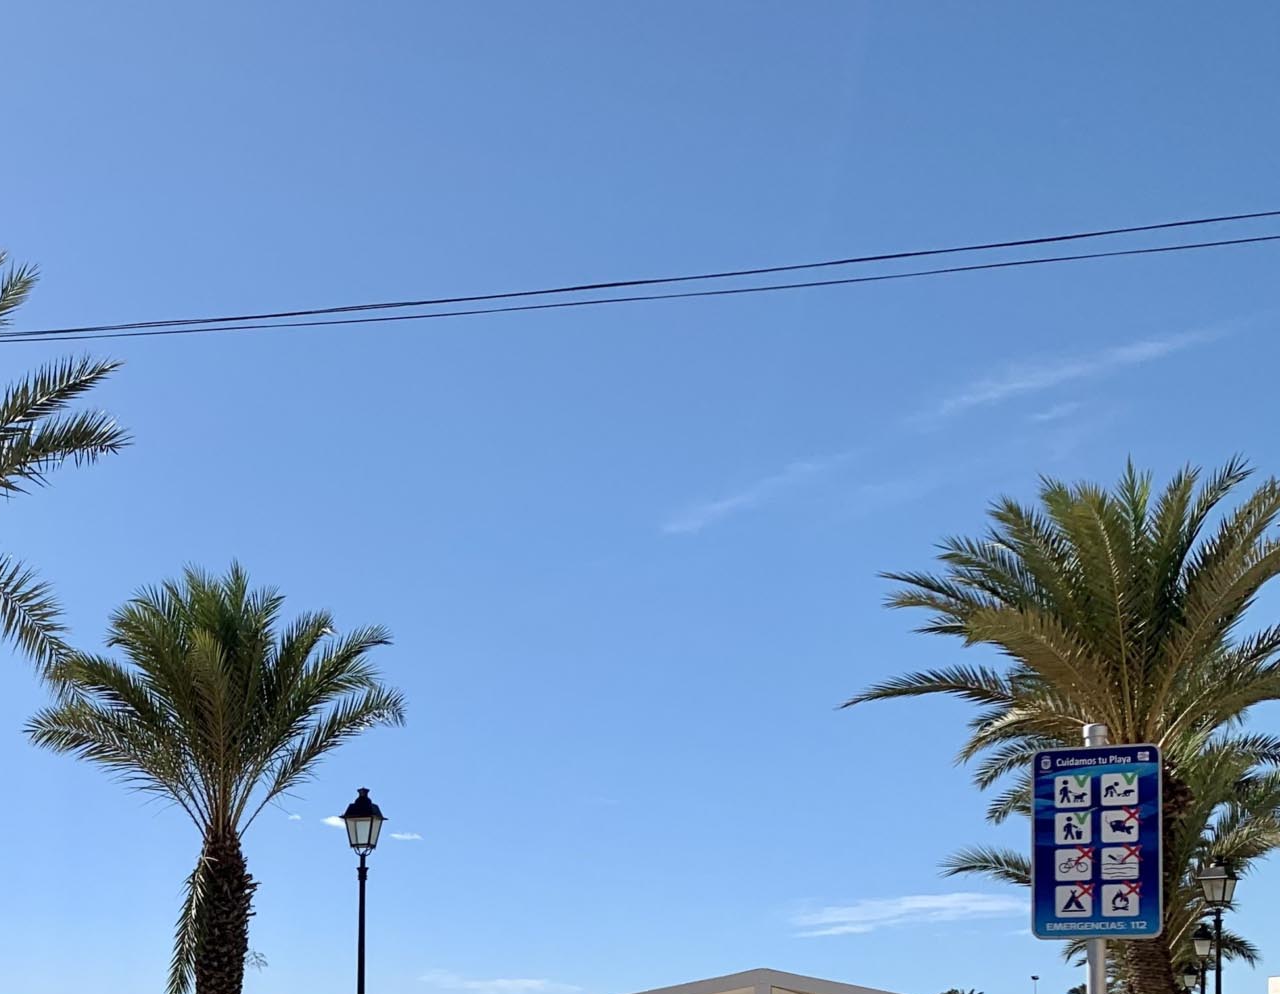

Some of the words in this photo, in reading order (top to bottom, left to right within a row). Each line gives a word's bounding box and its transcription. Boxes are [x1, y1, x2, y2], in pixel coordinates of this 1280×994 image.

[1056, 757, 1097, 767] Cuidamos
[1098, 757, 1107, 765] tu
[1109, 755, 1131, 764] Playa
[1046, 921, 1127, 931] EMERGENCIAS:
[1130, 921, 1148, 929] 112
